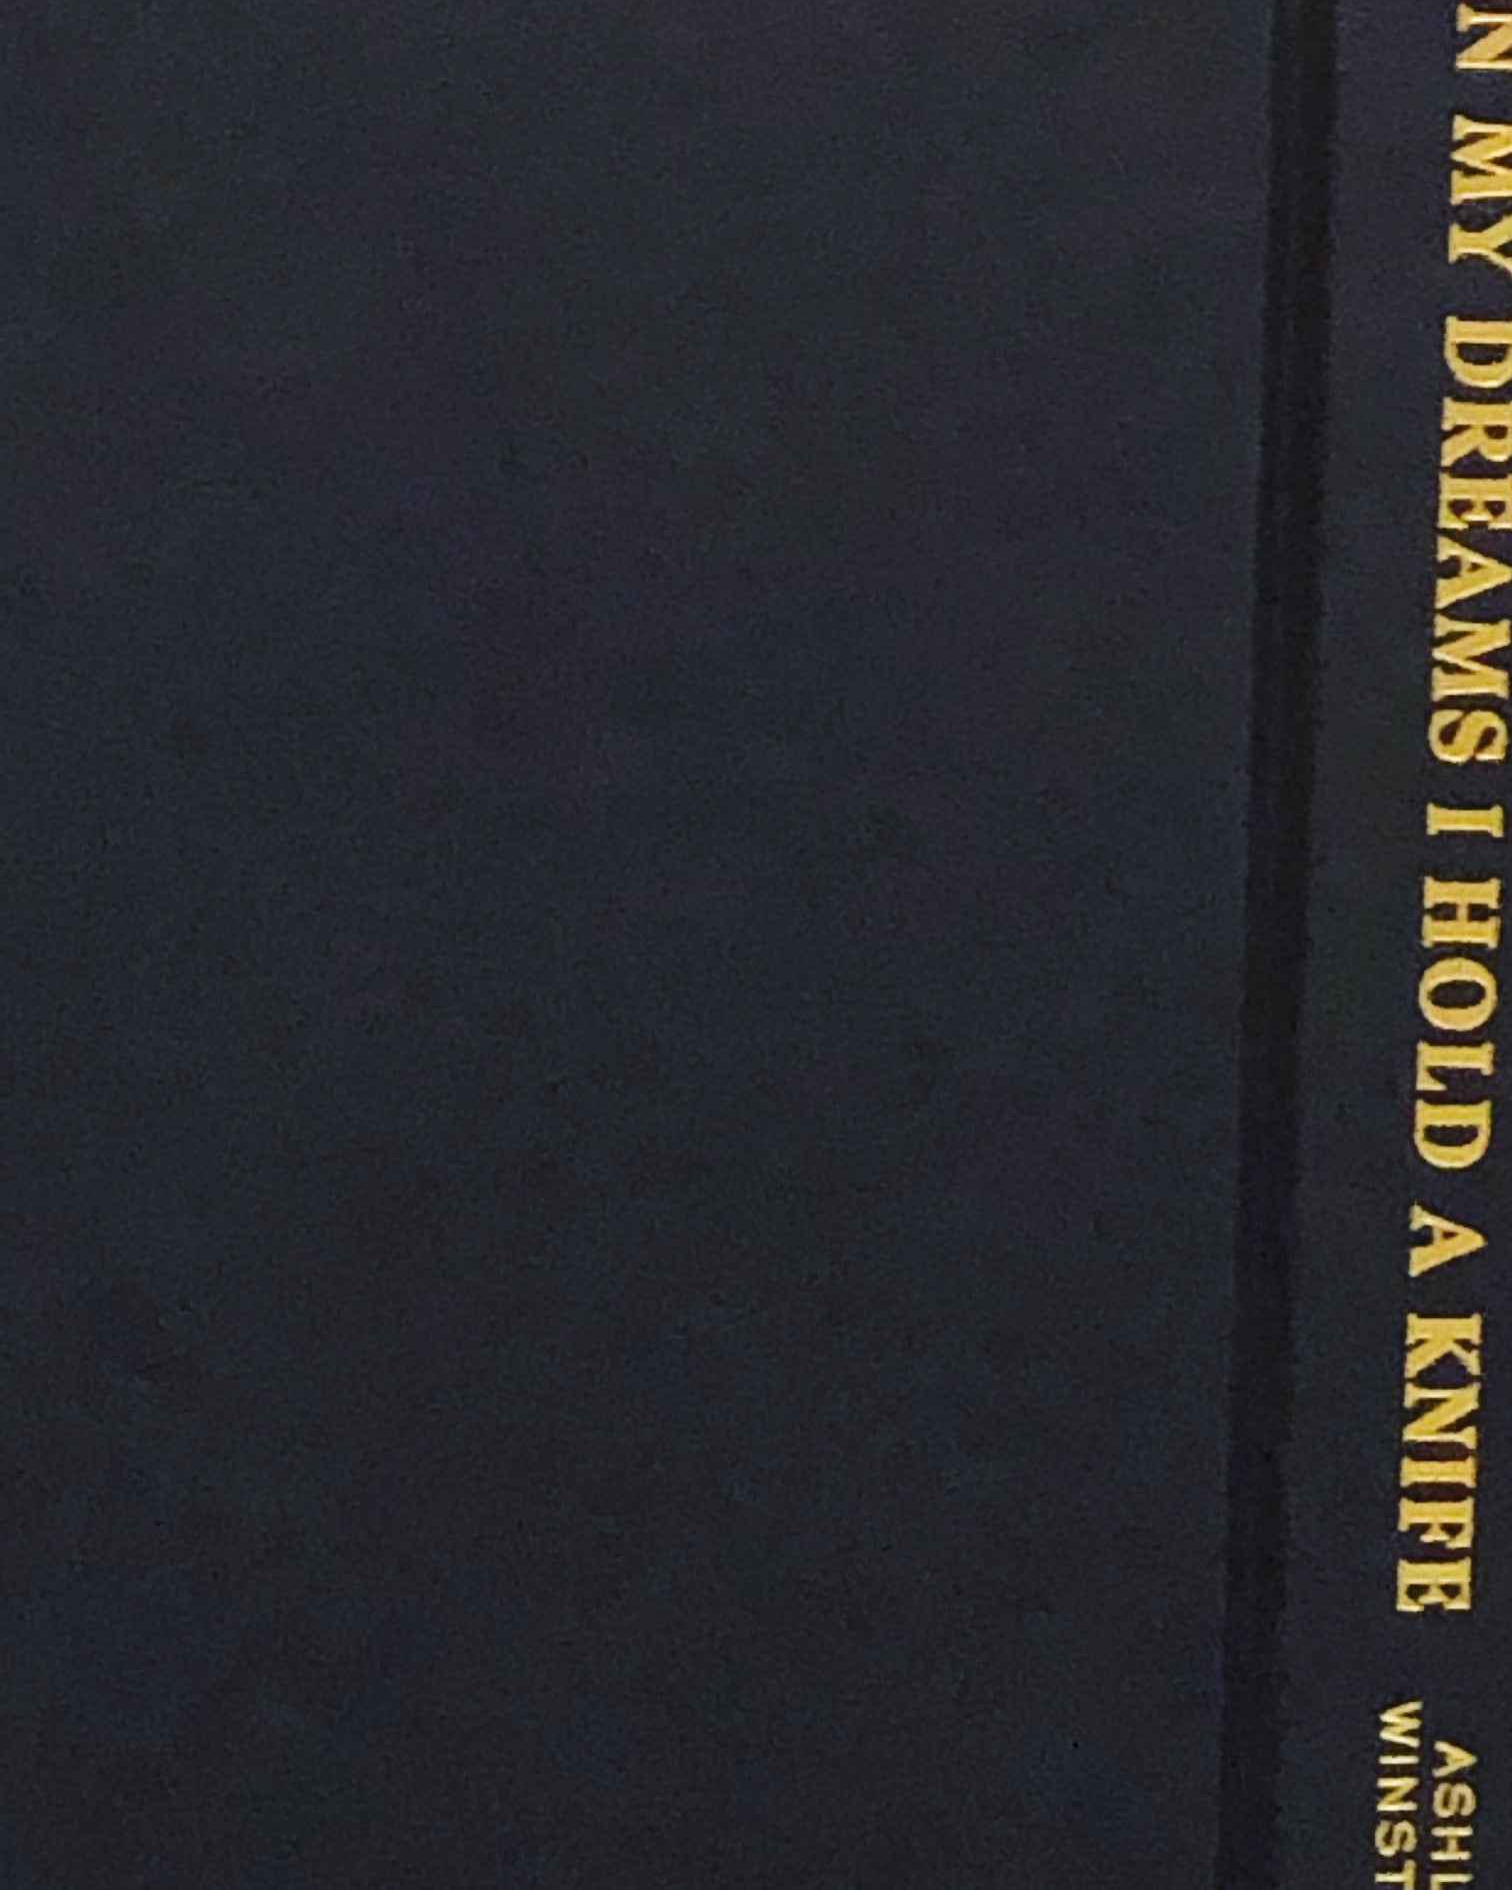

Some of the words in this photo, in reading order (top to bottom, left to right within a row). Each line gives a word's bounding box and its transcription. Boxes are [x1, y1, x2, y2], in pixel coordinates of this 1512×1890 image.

[1426, 803, 1504, 838] I
[1413, 876, 1501, 1170] HOLD
[1409, 1205, 1488, 1277] A
[1396, 1313, 1483, 1613] KNIFE
